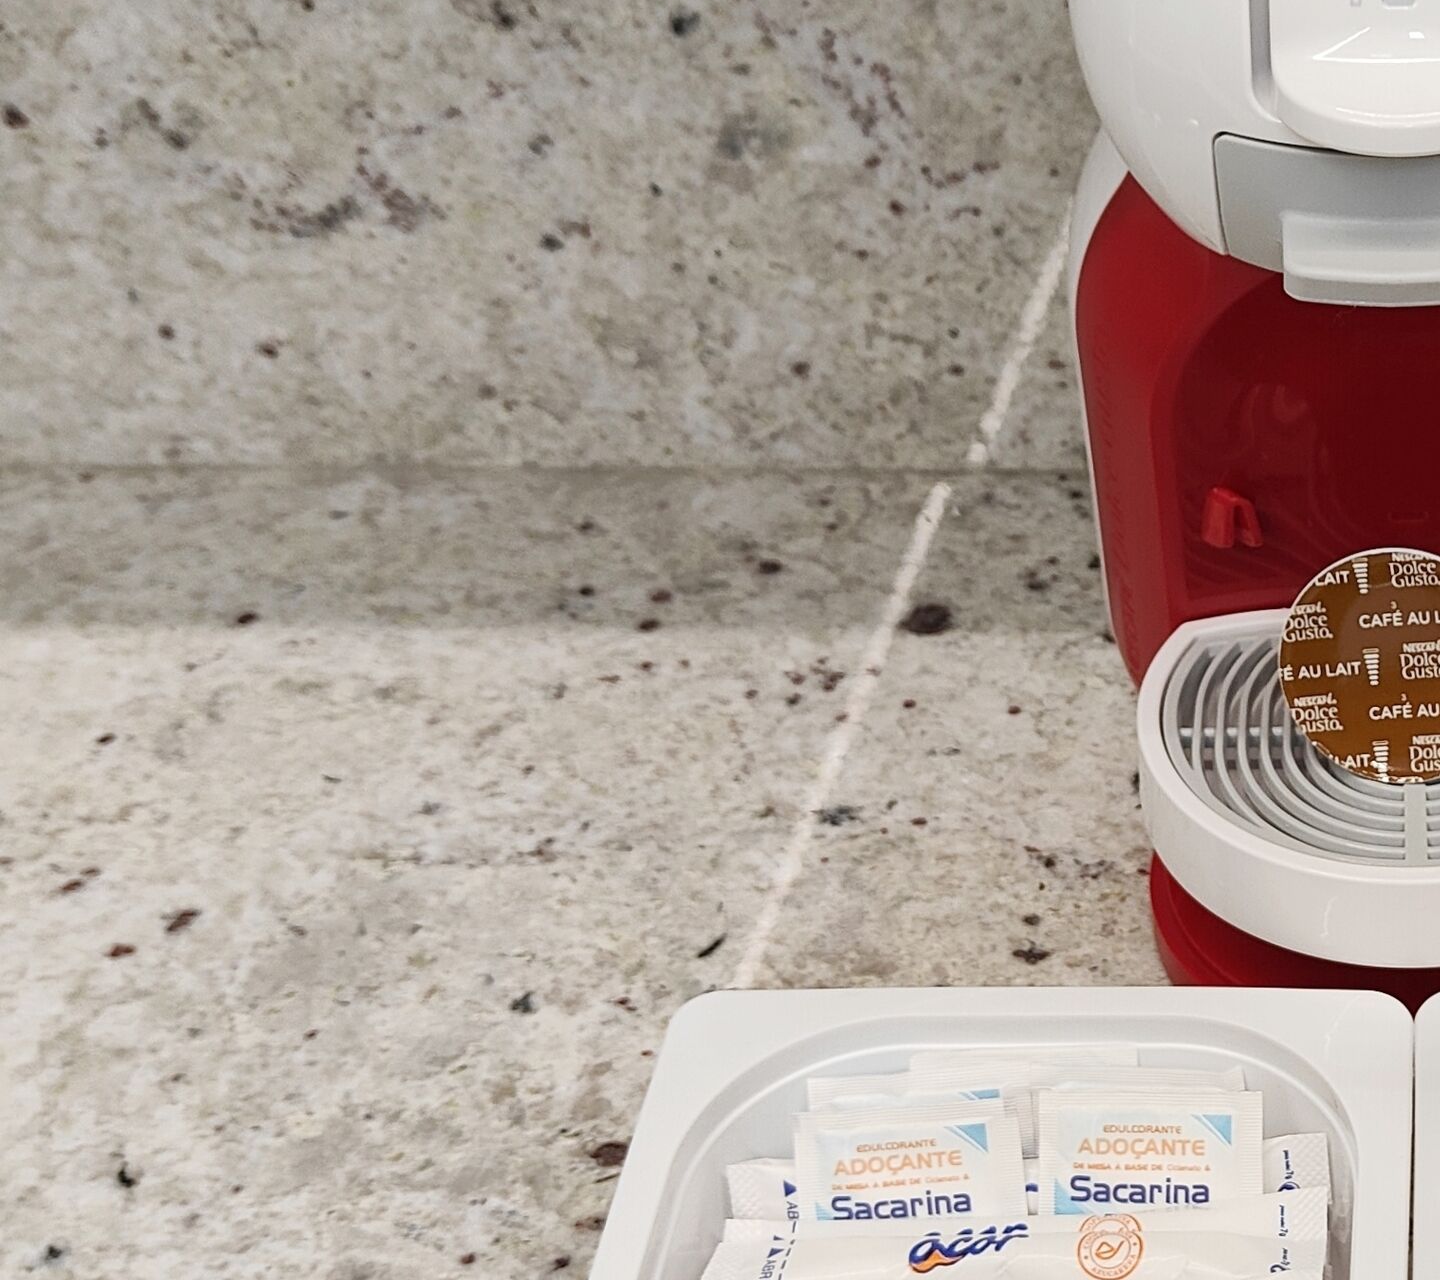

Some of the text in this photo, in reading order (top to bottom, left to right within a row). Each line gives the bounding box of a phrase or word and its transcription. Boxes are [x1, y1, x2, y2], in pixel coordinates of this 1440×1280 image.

[1388, 561, 1437, 576] Dolce
[1315, 570, 1350, 587] LAIT
[1359, 608, 1404, 629] CAFÉ
[1407, 610, 1431, 625] AU
[1282, 626, 1332, 643] Gusto
[1298, 664, 1322, 679] AU
[1325, 661, 1362, 677] LAIT
[1290, 704, 1339, 722] Dolce
[1368, 701, 1413, 720] CAFÉ
[1416, 703, 1440, 718] AU
[1103, 1124, 1182, 1135] EDULCORANTE
[856, 1138, 937, 1153] EDULCORANTE
[1077, 1137, 1206, 1160] ADOÇANTE
[834, 1150, 963, 1176] ADOÇANTE
[1124, 1162, 1149, 1171] BASE
[1151, 1163, 1163, 1172] DE
[1069, 1174, 1210, 1205] Sacarina
[830, 1190, 973, 1221] Sacarina
